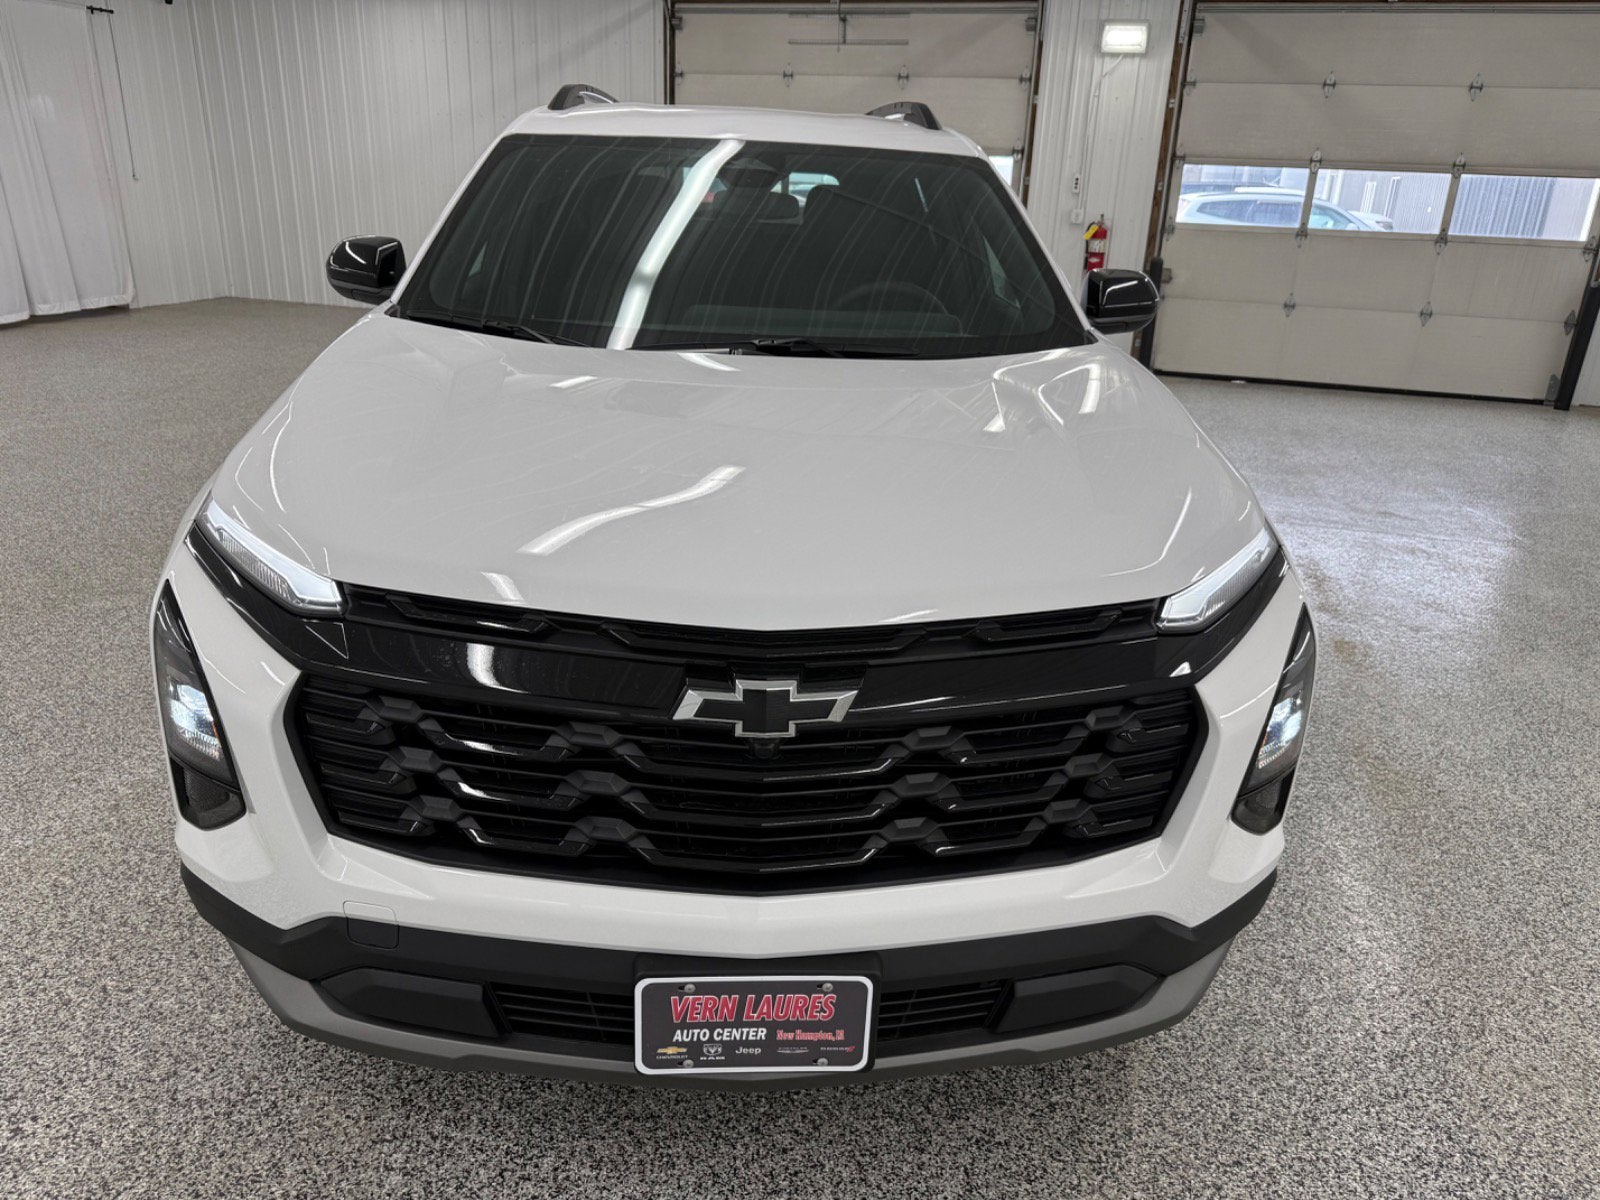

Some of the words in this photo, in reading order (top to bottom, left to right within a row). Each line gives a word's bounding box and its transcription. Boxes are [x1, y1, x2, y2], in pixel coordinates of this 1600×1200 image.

[670, 994, 739, 1023] VERN
[743, 993, 837, 1021] LAURES
[672, 1029, 709, 1042] AUTO
[713, 1027, 767, 1041] CENTER
[776, 1029, 794, 1041] New
[735, 1046, 762, 1055] Jeep
